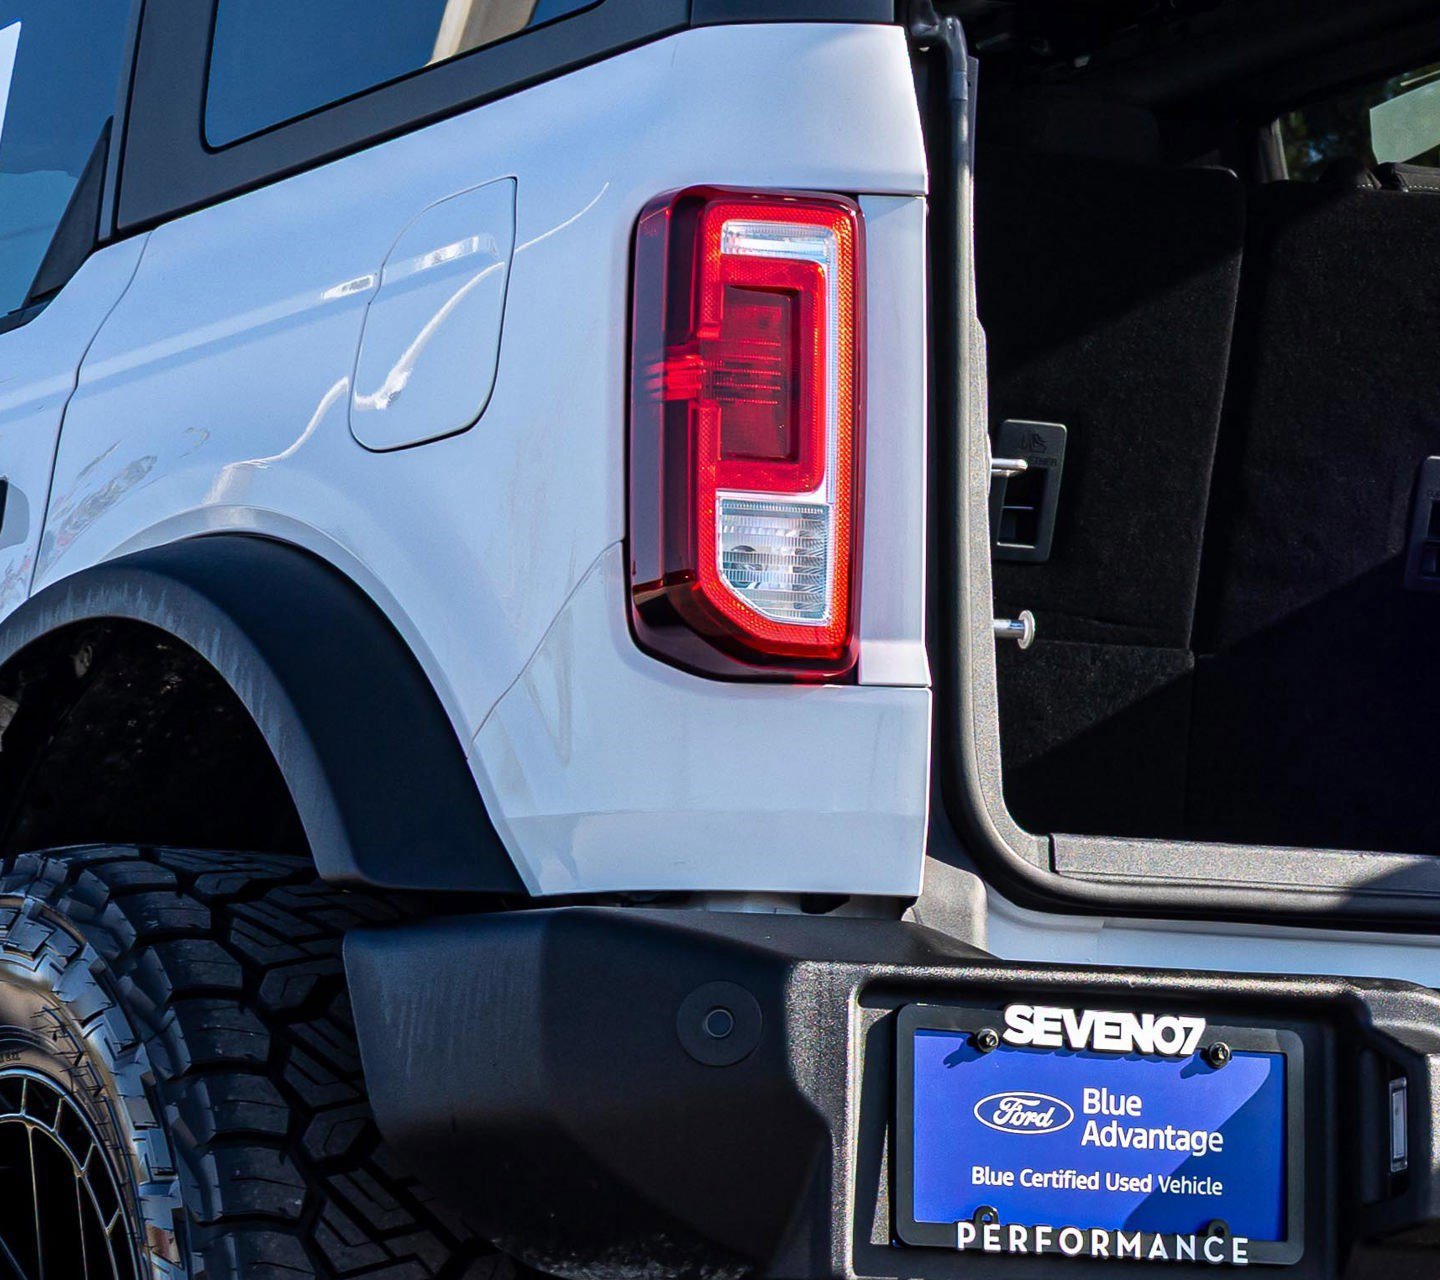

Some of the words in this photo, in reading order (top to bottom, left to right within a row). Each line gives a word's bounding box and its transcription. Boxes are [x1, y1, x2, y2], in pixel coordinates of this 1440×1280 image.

[1082, 1088, 1142, 1117] Blue
[1081, 1121, 1224, 1157] Advantage
[971, 1166, 1014, 1187] Blue
[1019, 1168, 1100, 1191] Certified
[1105, 1172, 1153, 1194] Used
[1158, 1175, 1224, 1196] Vehicle
[957, 1222, 1249, 1264] PERFORMANCE
